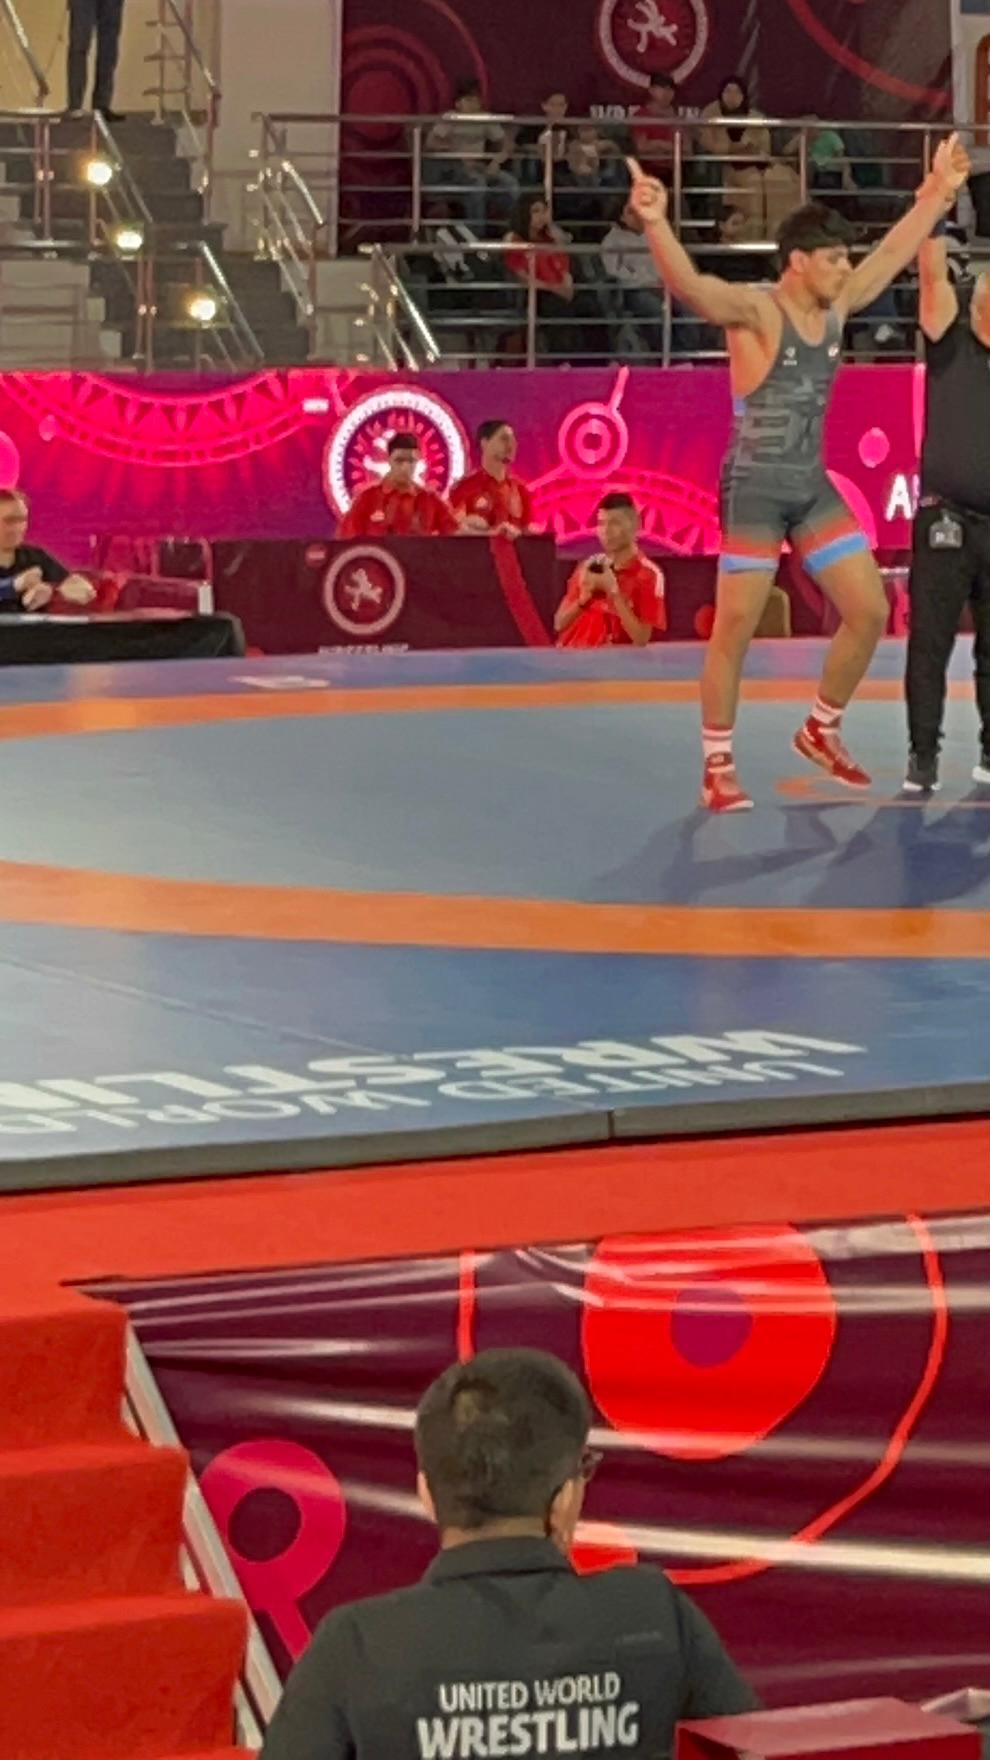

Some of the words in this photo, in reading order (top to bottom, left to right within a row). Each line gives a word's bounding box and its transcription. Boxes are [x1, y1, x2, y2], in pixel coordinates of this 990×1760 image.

[437, 1060, 846, 1101] UNITED
[0, 1089, 432, 1134] WORLD
[439, 1680, 530, 1713] UNITED
[534, 1671, 621, 1705] WORLD
[416, 1701, 640, 1759] WRESTLING
